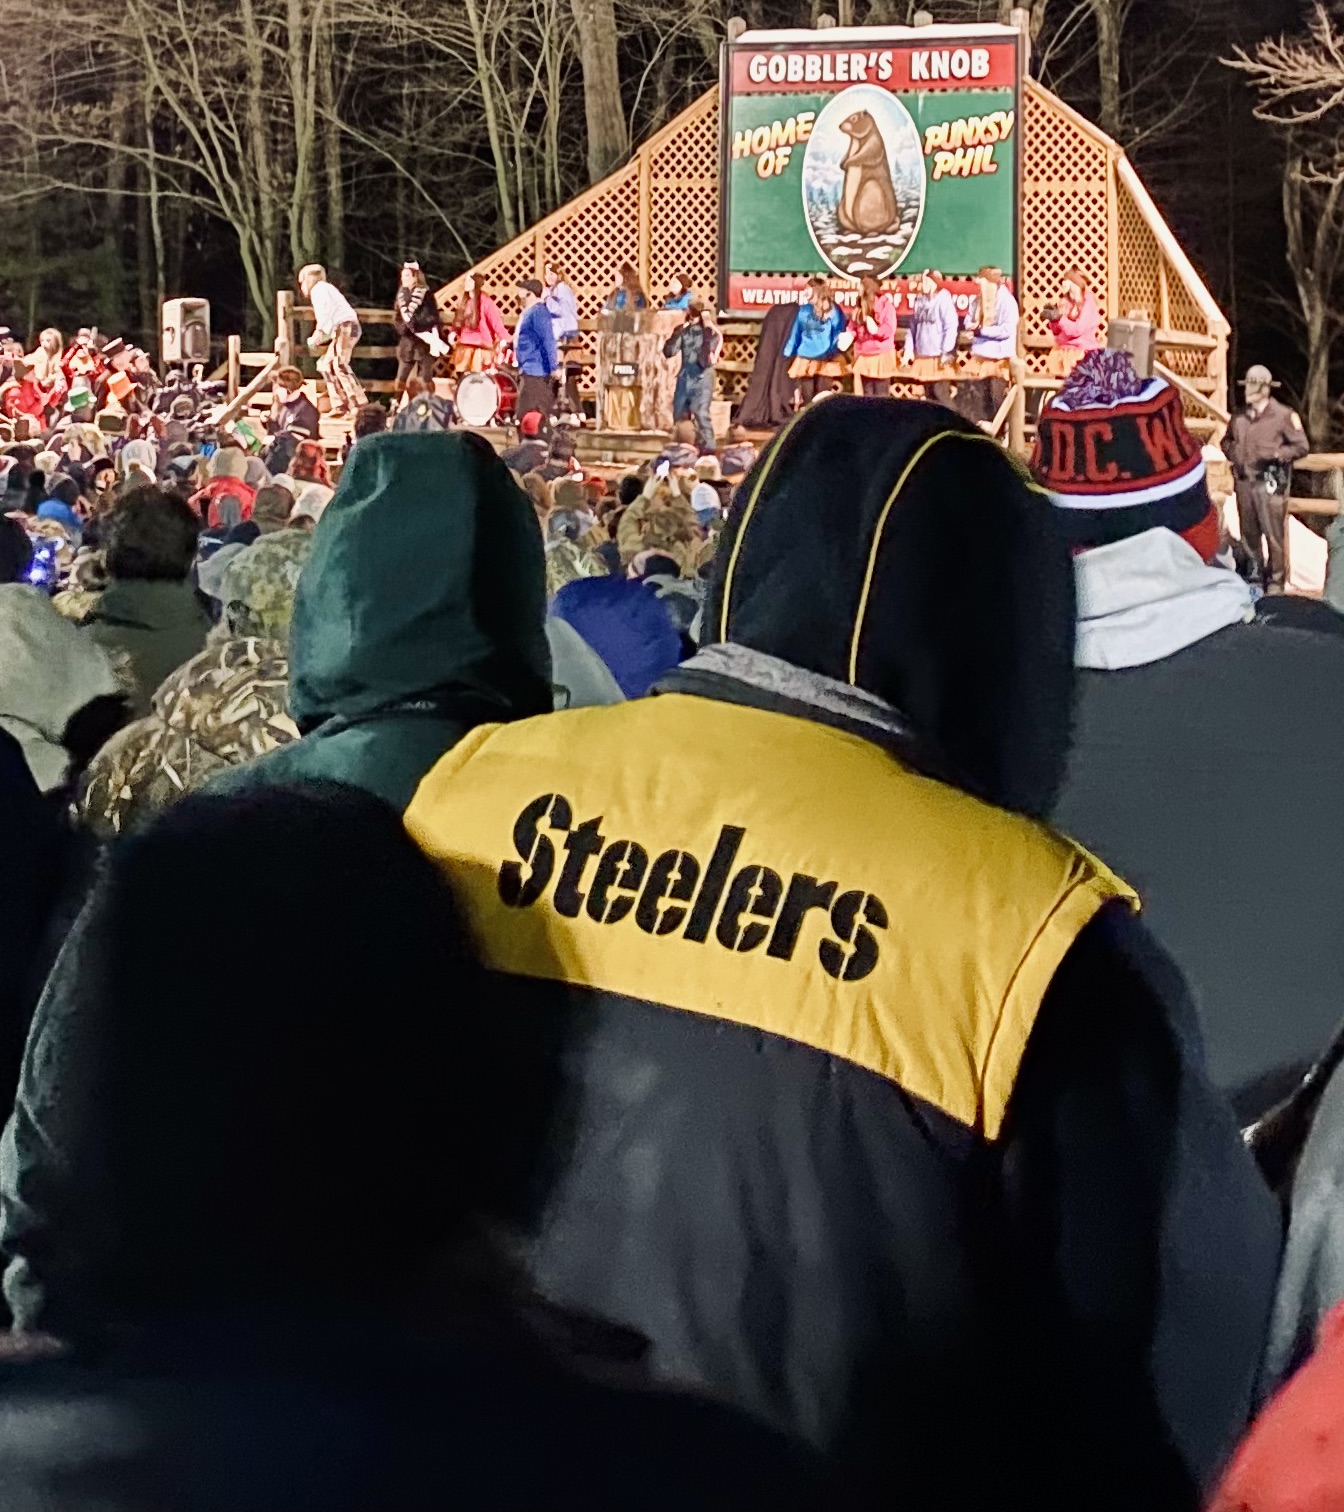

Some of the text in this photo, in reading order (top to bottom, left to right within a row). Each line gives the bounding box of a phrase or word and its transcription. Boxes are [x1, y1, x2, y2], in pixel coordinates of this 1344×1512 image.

[749, 49, 990, 83] GOBBLER'S KNOB
[732, 112, 816, 160] HOME
[923, 111, 1015, 155] PUNXSY
[757, 147, 792, 179] OF
[931, 145, 998, 181] PHIL
[498, 793, 889, 982] Steelers
